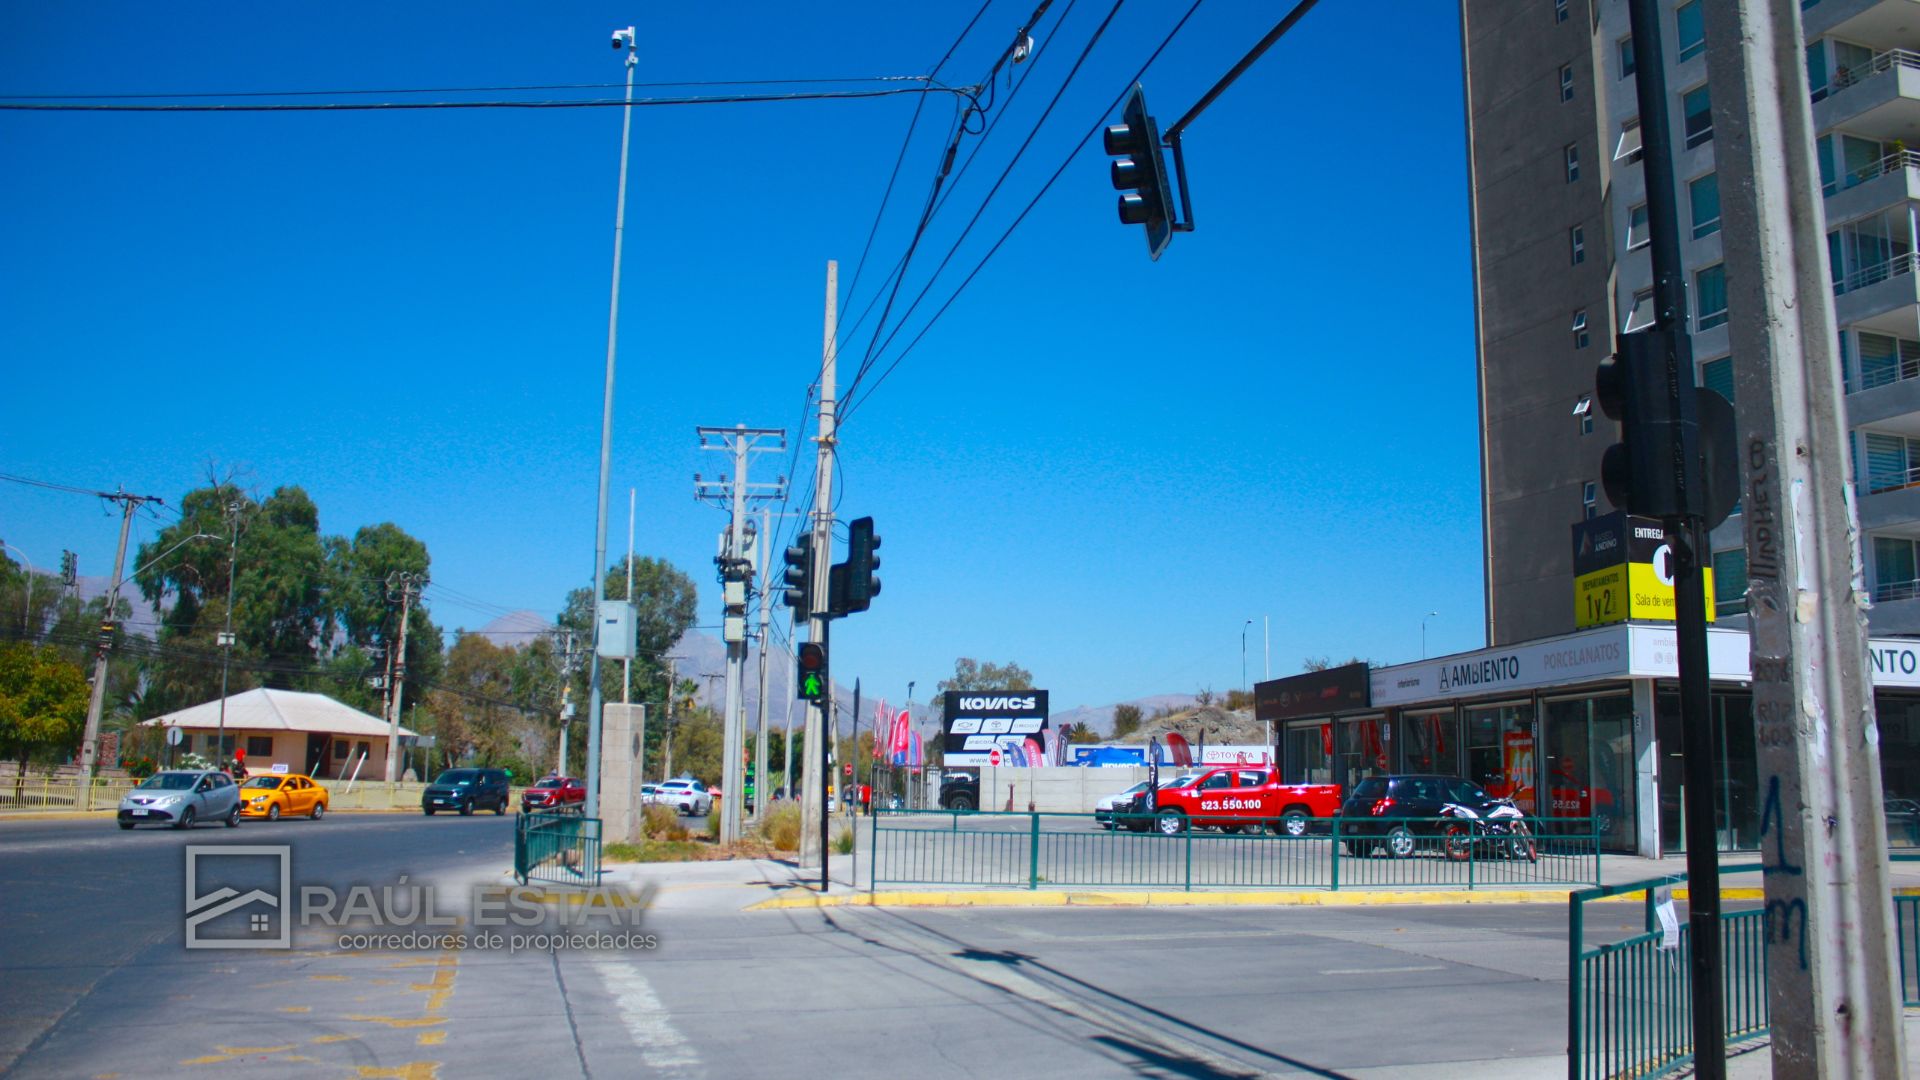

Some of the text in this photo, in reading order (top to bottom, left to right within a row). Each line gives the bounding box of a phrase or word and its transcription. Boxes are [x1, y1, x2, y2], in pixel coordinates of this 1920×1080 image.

[1586, 594, 1593, 619] 1
[1594, 598, 1601, 622] y
[1603, 589, 1611, 616] 2
[1635, 593, 1651, 607] Sala
[1652, 595, 1661, 607] de
[1543, 642, 1620, 670] PORCELANATOS
[1451, 655, 1519, 687] AMBIENTO
[959, 697, 1036, 710] KOVACS
[1201, 800, 1261, 811] $23.550.100
